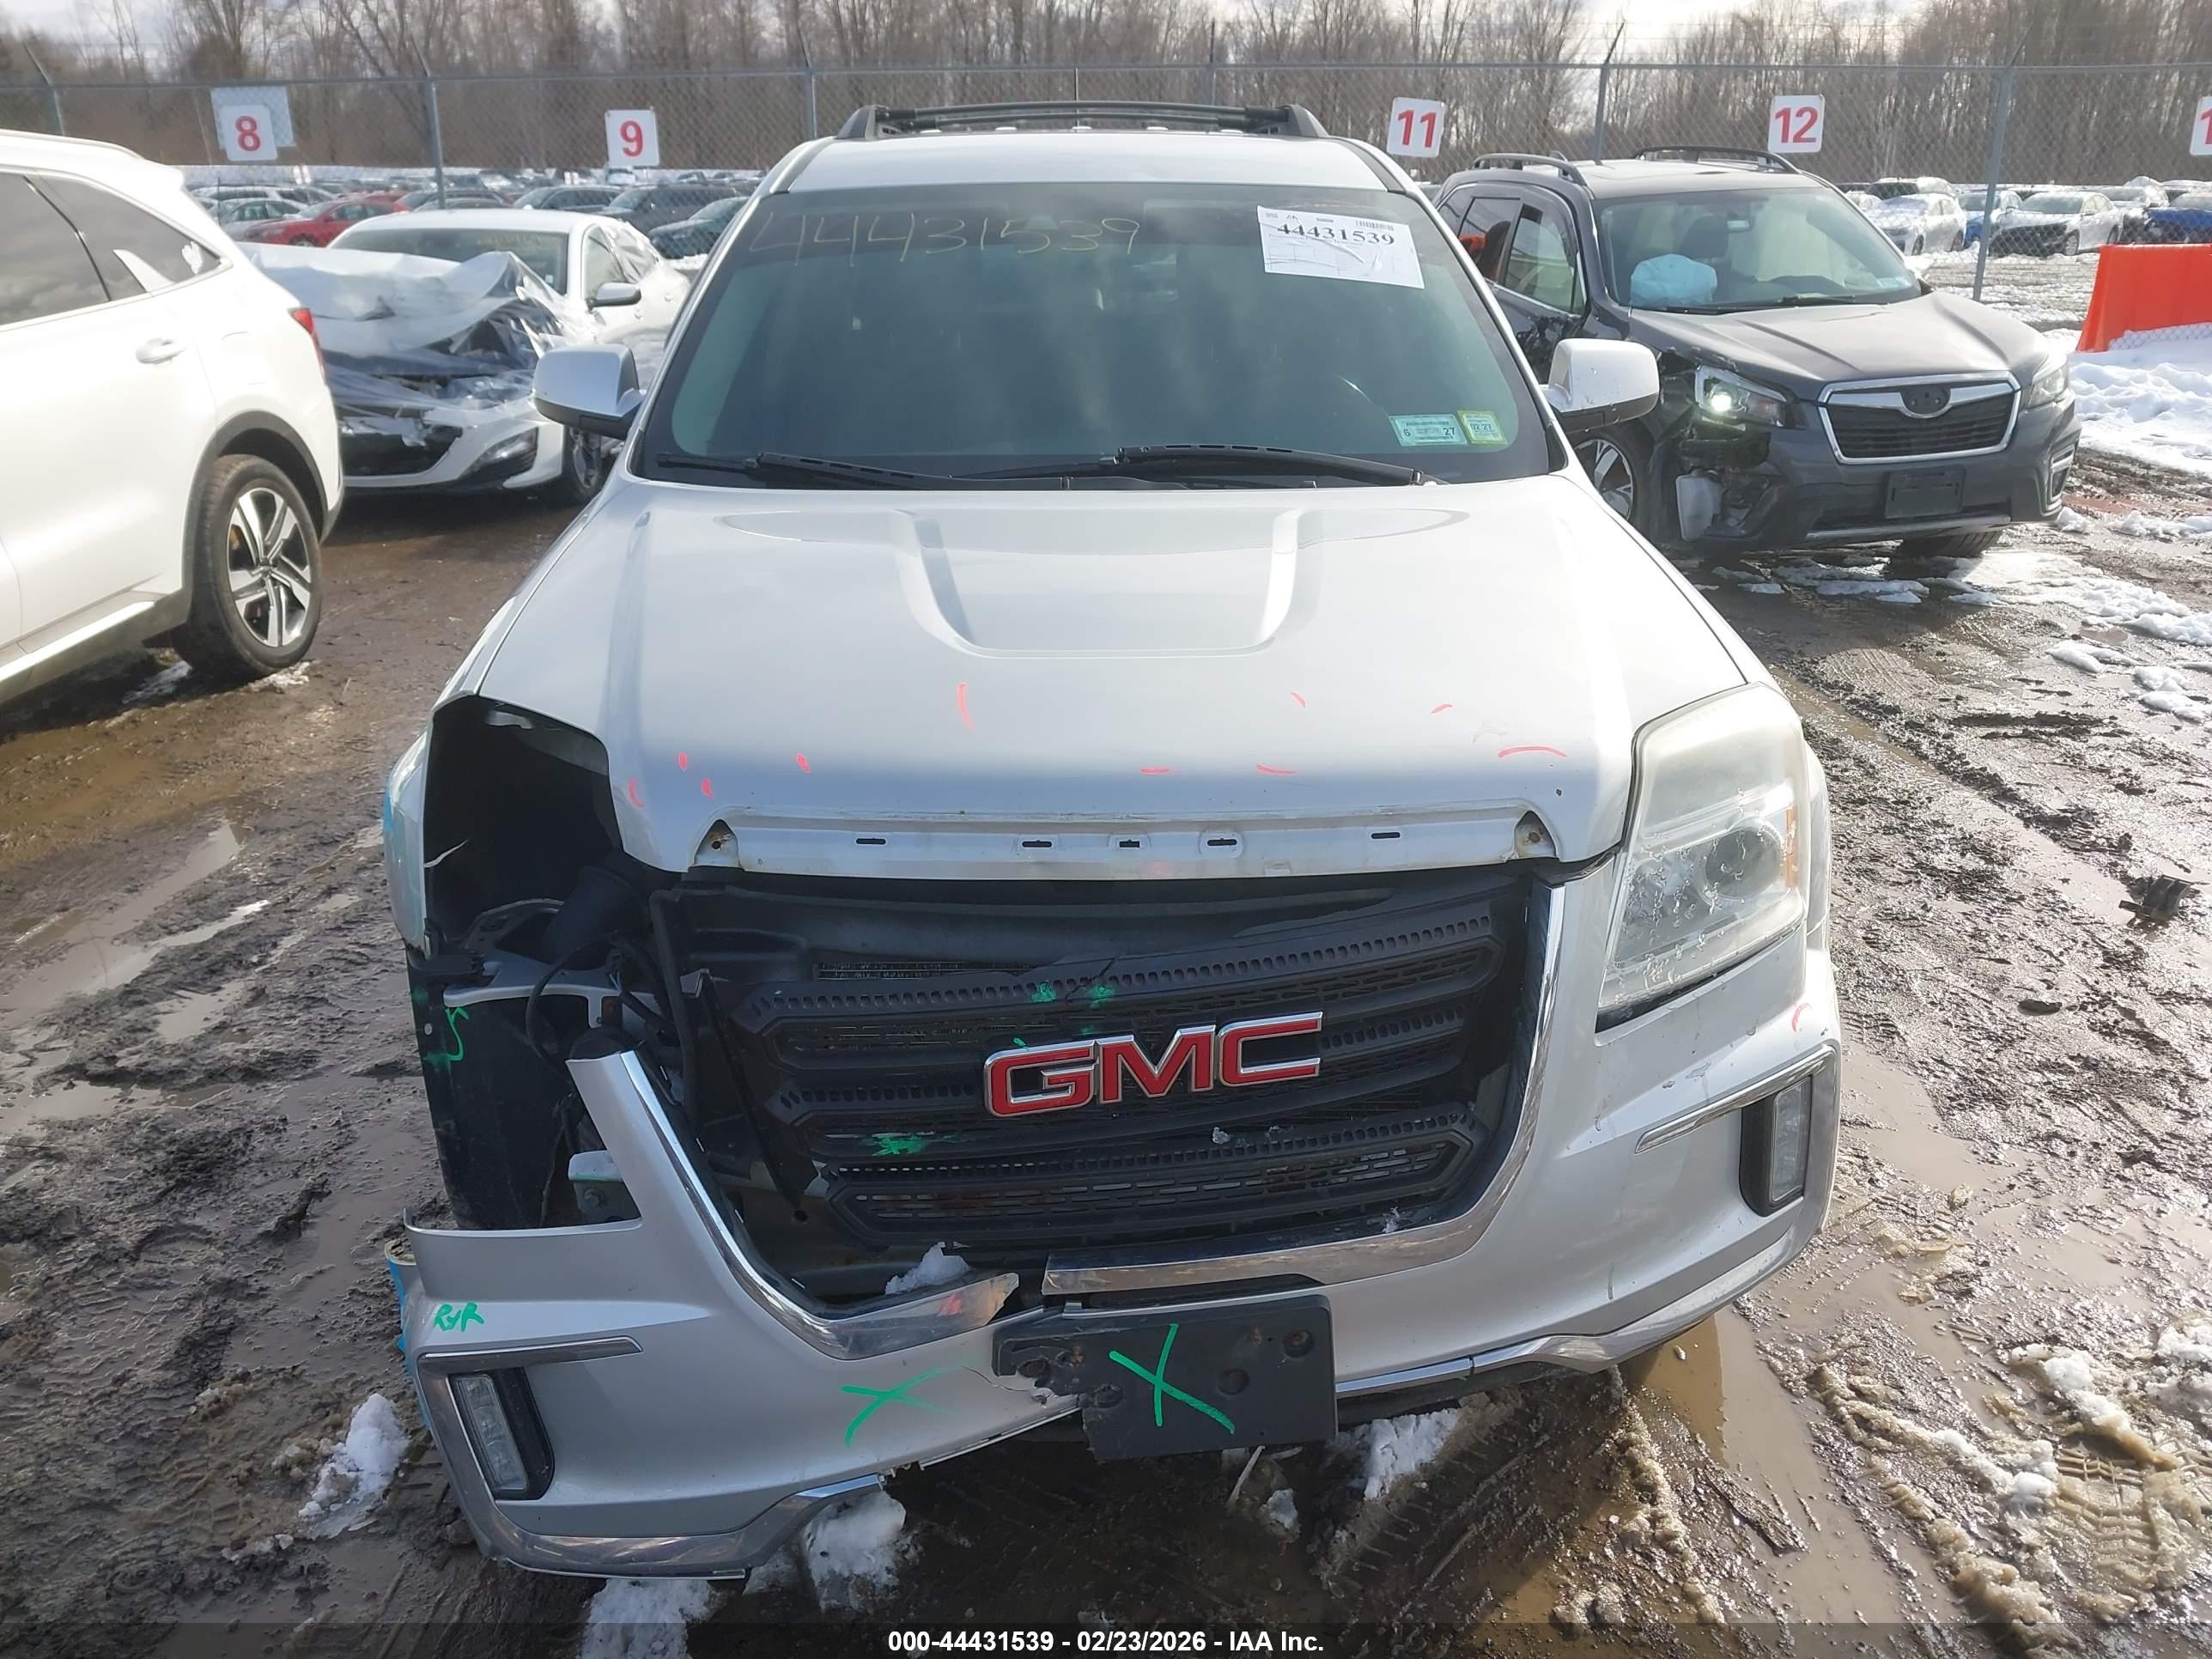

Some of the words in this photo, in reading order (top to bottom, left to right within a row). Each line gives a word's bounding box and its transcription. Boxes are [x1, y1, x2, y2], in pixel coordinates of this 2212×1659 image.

[234, 115, 261, 152] 8
[620, 120, 643, 158] 9
[1398, 109, 1437, 148] 11
[1775, 106, 1818, 143] 12
[2200, 108, 2212, 145] 1
[749, 212, 1140, 267] 44431539
[1277, 223, 1395, 246] 44431539
[1442, 427, 1455, 435] 27
[984, 1011, 1323, 1116] GMC
